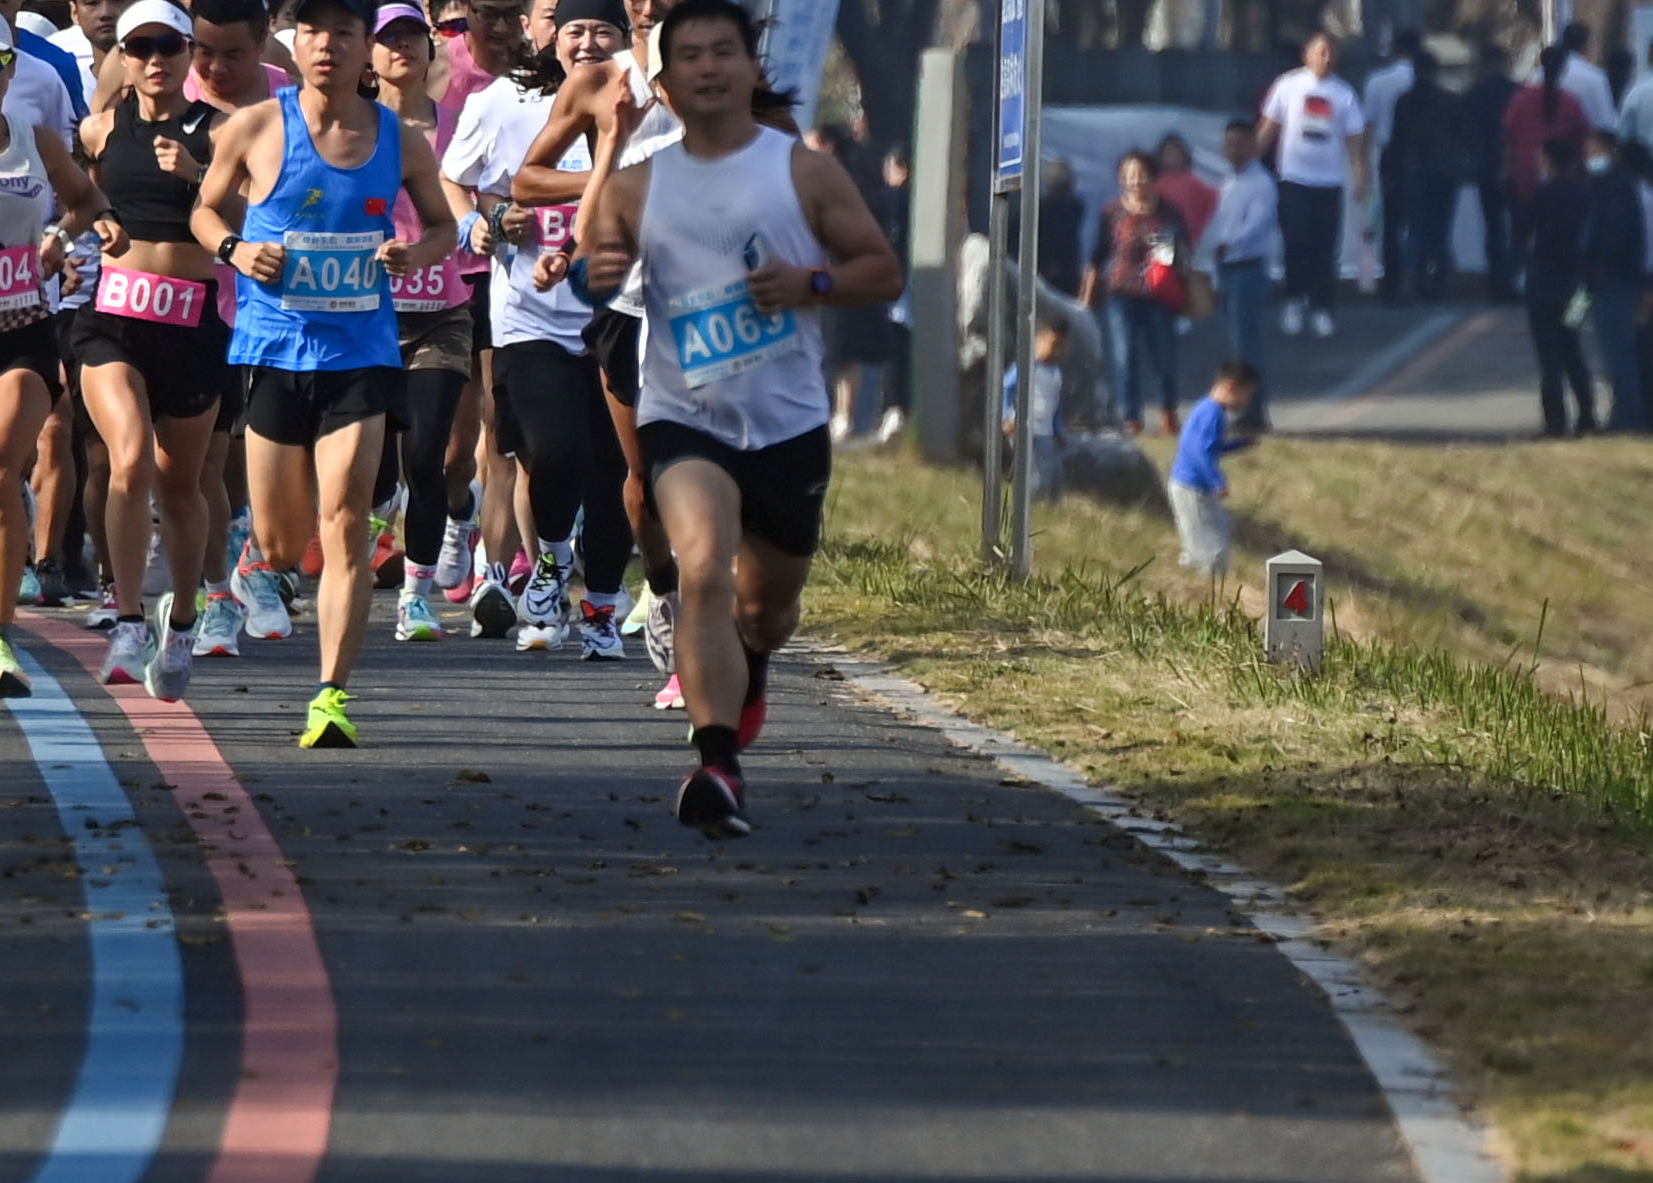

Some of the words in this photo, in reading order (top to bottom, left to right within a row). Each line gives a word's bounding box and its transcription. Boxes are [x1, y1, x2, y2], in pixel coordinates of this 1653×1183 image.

[290, 256, 377, 291] A040
[103, 273, 194, 319] B001
[1282, 580, 1310, 613] 4
